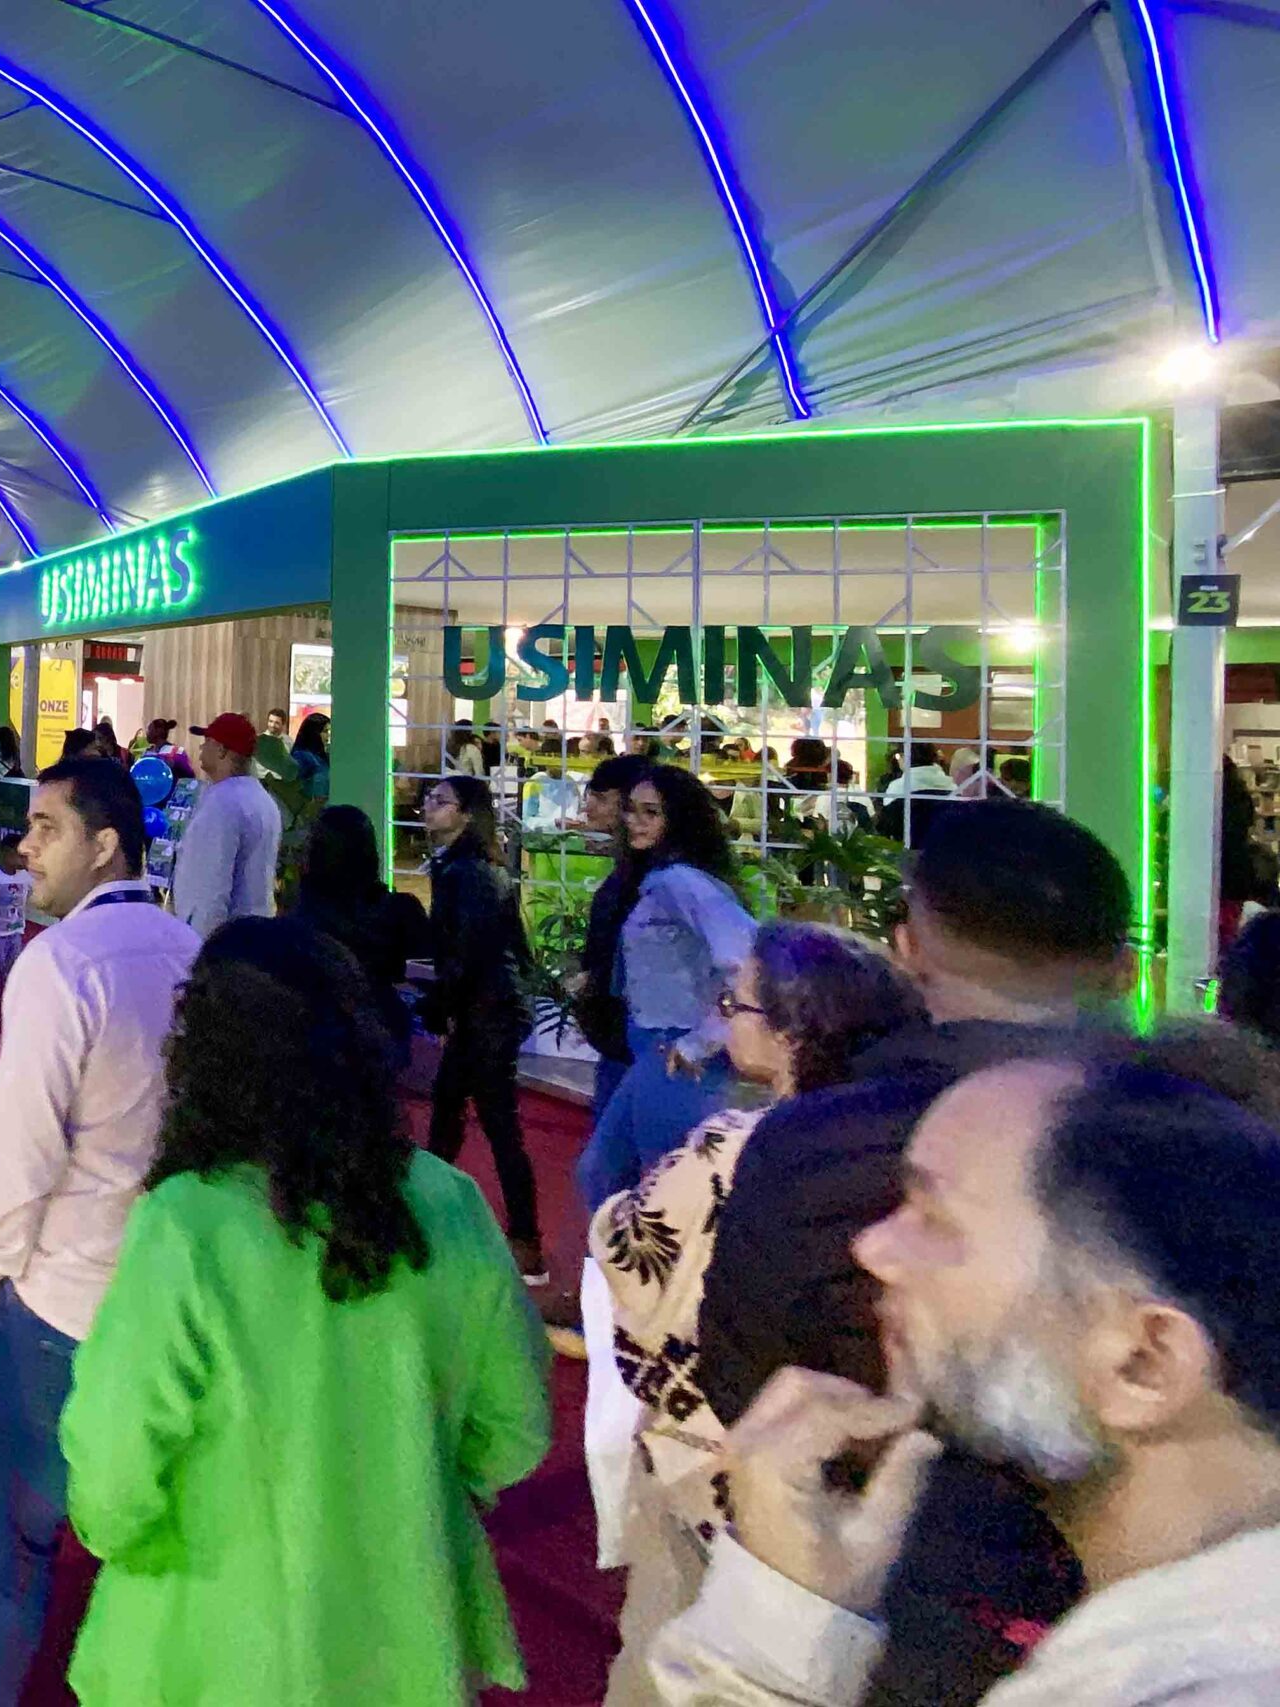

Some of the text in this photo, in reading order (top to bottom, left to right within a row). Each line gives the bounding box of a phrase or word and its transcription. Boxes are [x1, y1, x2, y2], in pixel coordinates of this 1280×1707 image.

[40, 526, 195, 627] USIMINAS
[1187, 591, 1231, 613] 23
[443, 625, 979, 712] USIMINAS
[40, 700, 69, 712] ONZE
